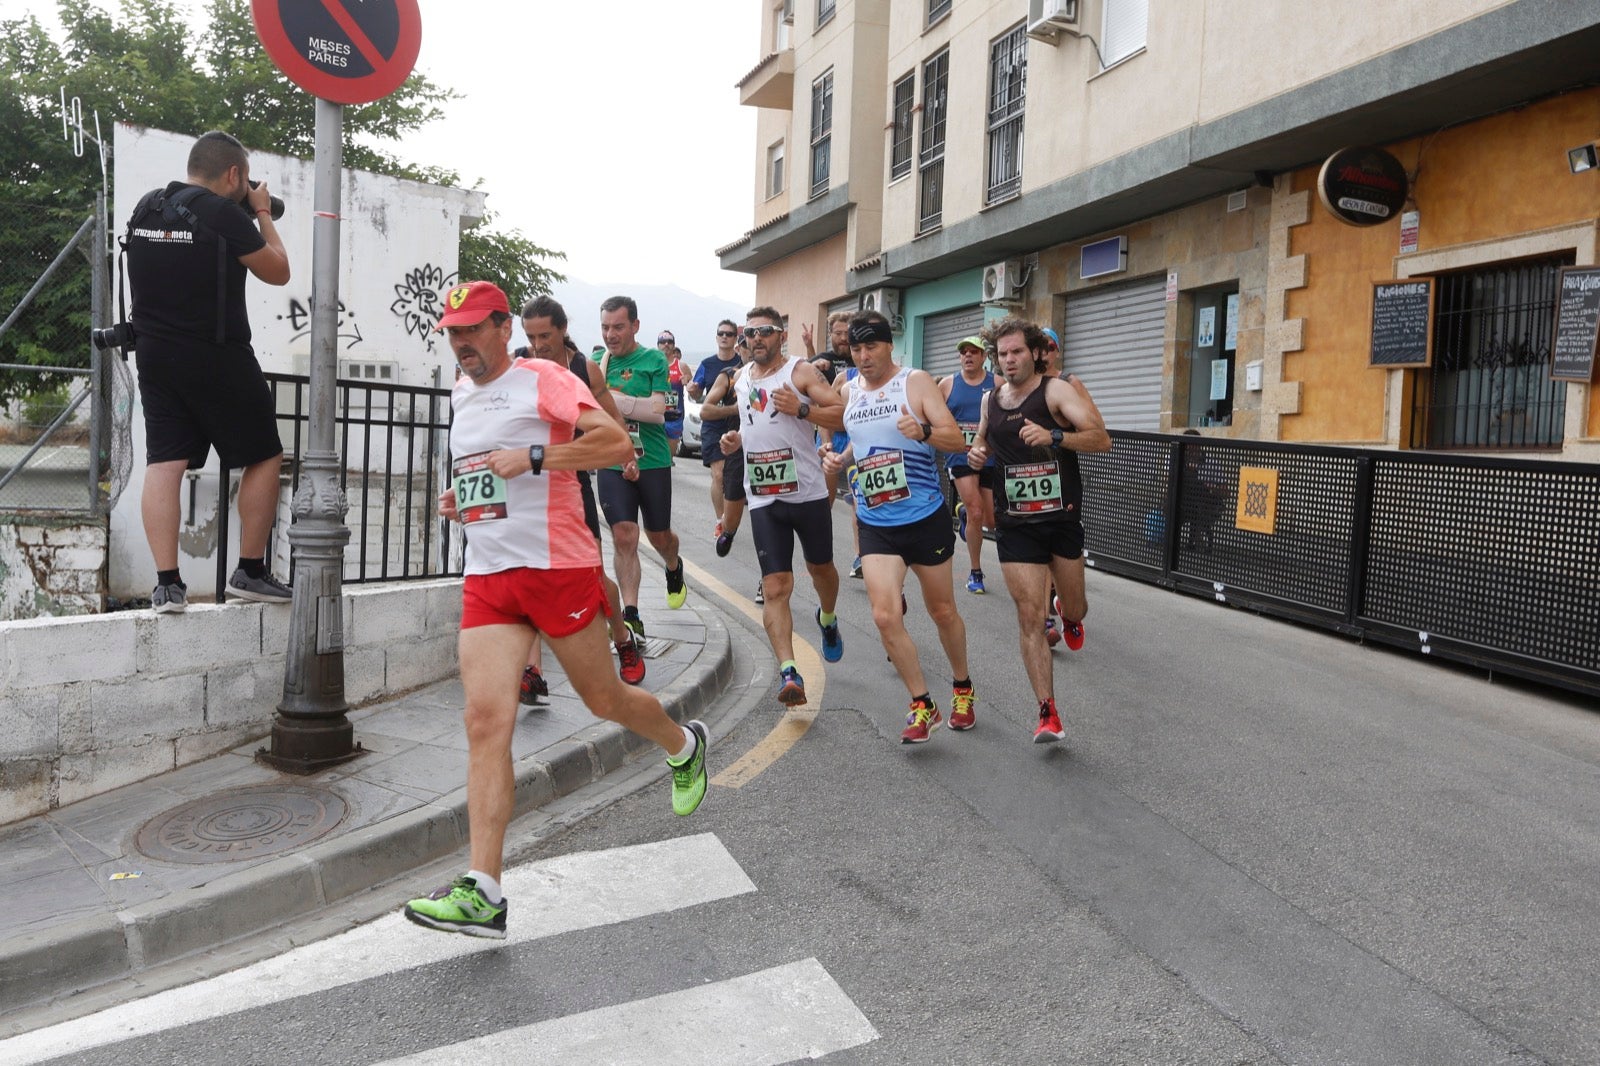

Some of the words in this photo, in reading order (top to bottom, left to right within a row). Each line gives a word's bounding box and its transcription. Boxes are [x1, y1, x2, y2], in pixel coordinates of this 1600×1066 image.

[309, 37, 351, 55] MESES
[308, 50, 348, 68] PARES
[850, 404, 897, 420] MARACENA
[754, 463, 787, 482] 947
[865, 467, 897, 490] 464
[458, 473, 495, 503] 678
[1014, 478, 1053, 498] 219
